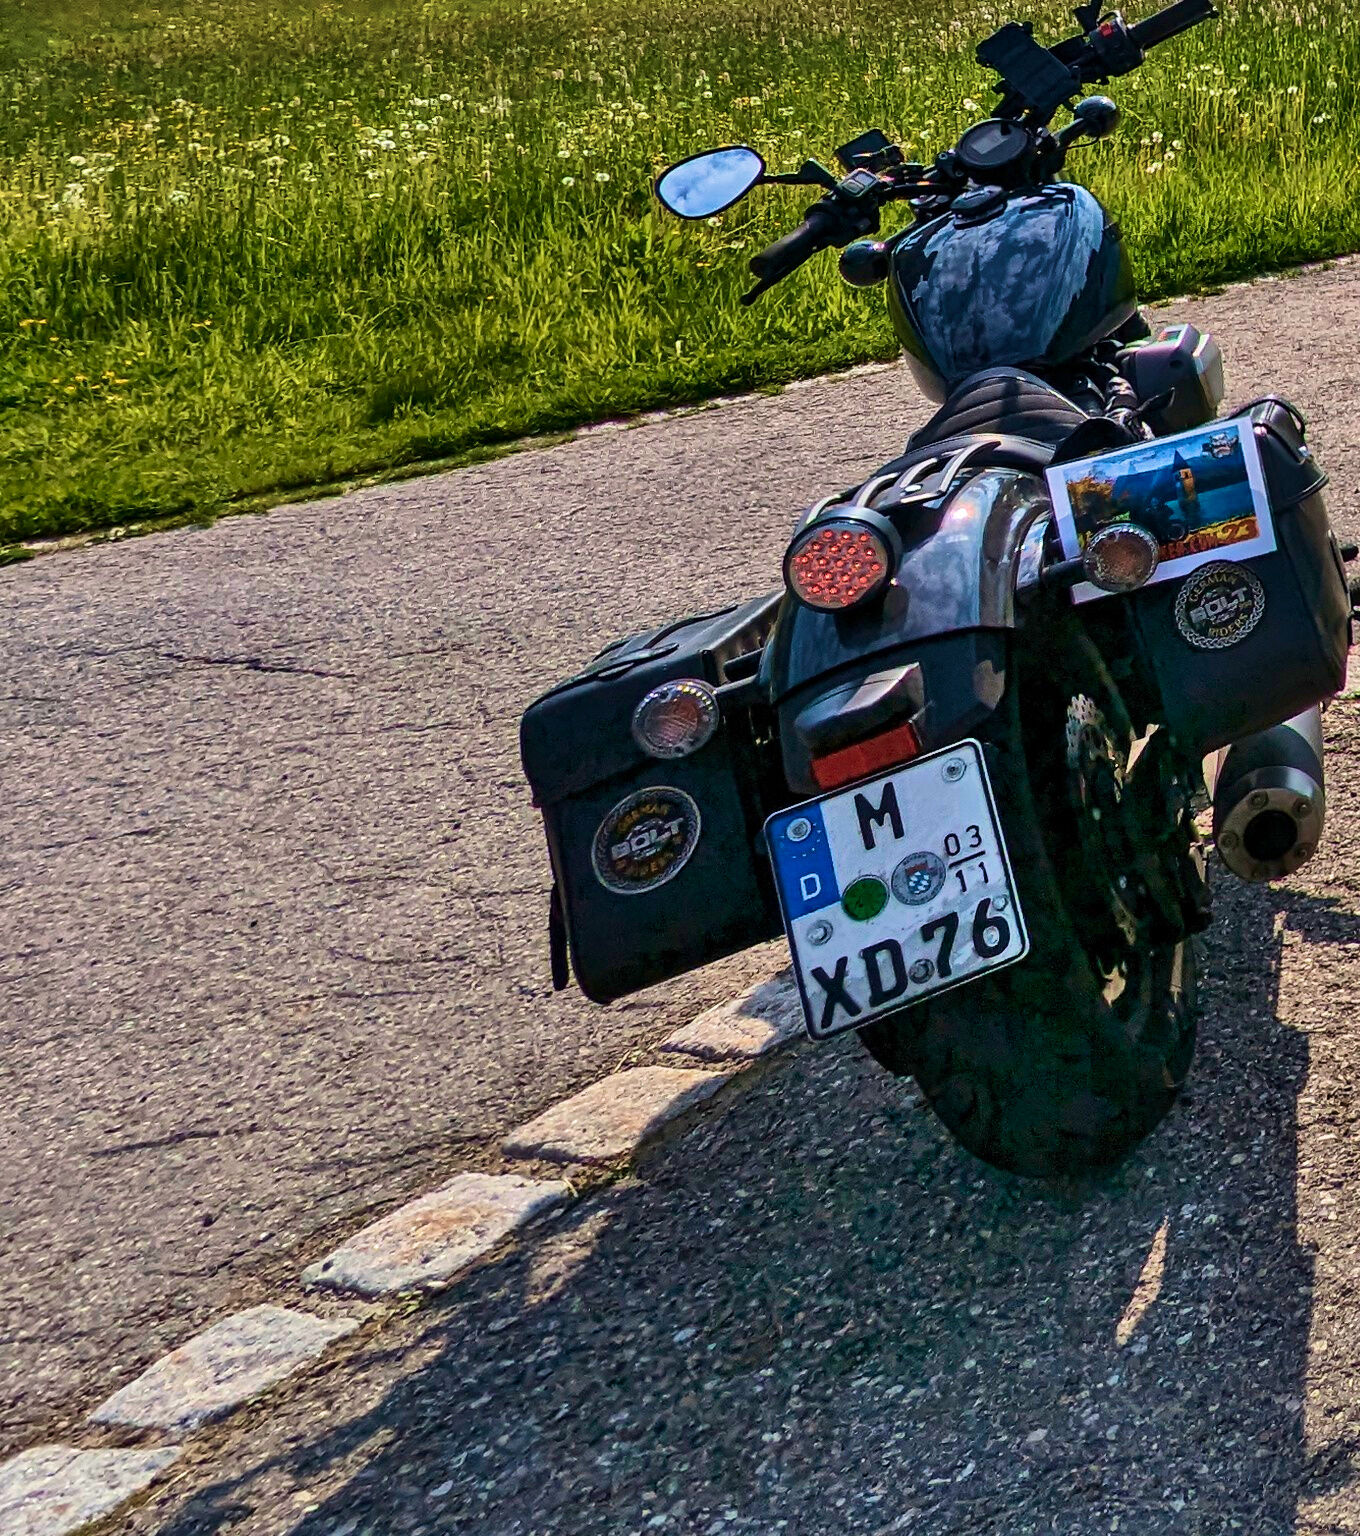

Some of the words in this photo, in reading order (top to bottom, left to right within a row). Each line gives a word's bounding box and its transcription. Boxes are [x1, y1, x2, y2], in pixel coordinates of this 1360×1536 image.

[853, 781, 905, 851] M
[943, 824, 983, 857] 03
[799, 872, 822, 902] D
[955, 861, 989, 893] 11
